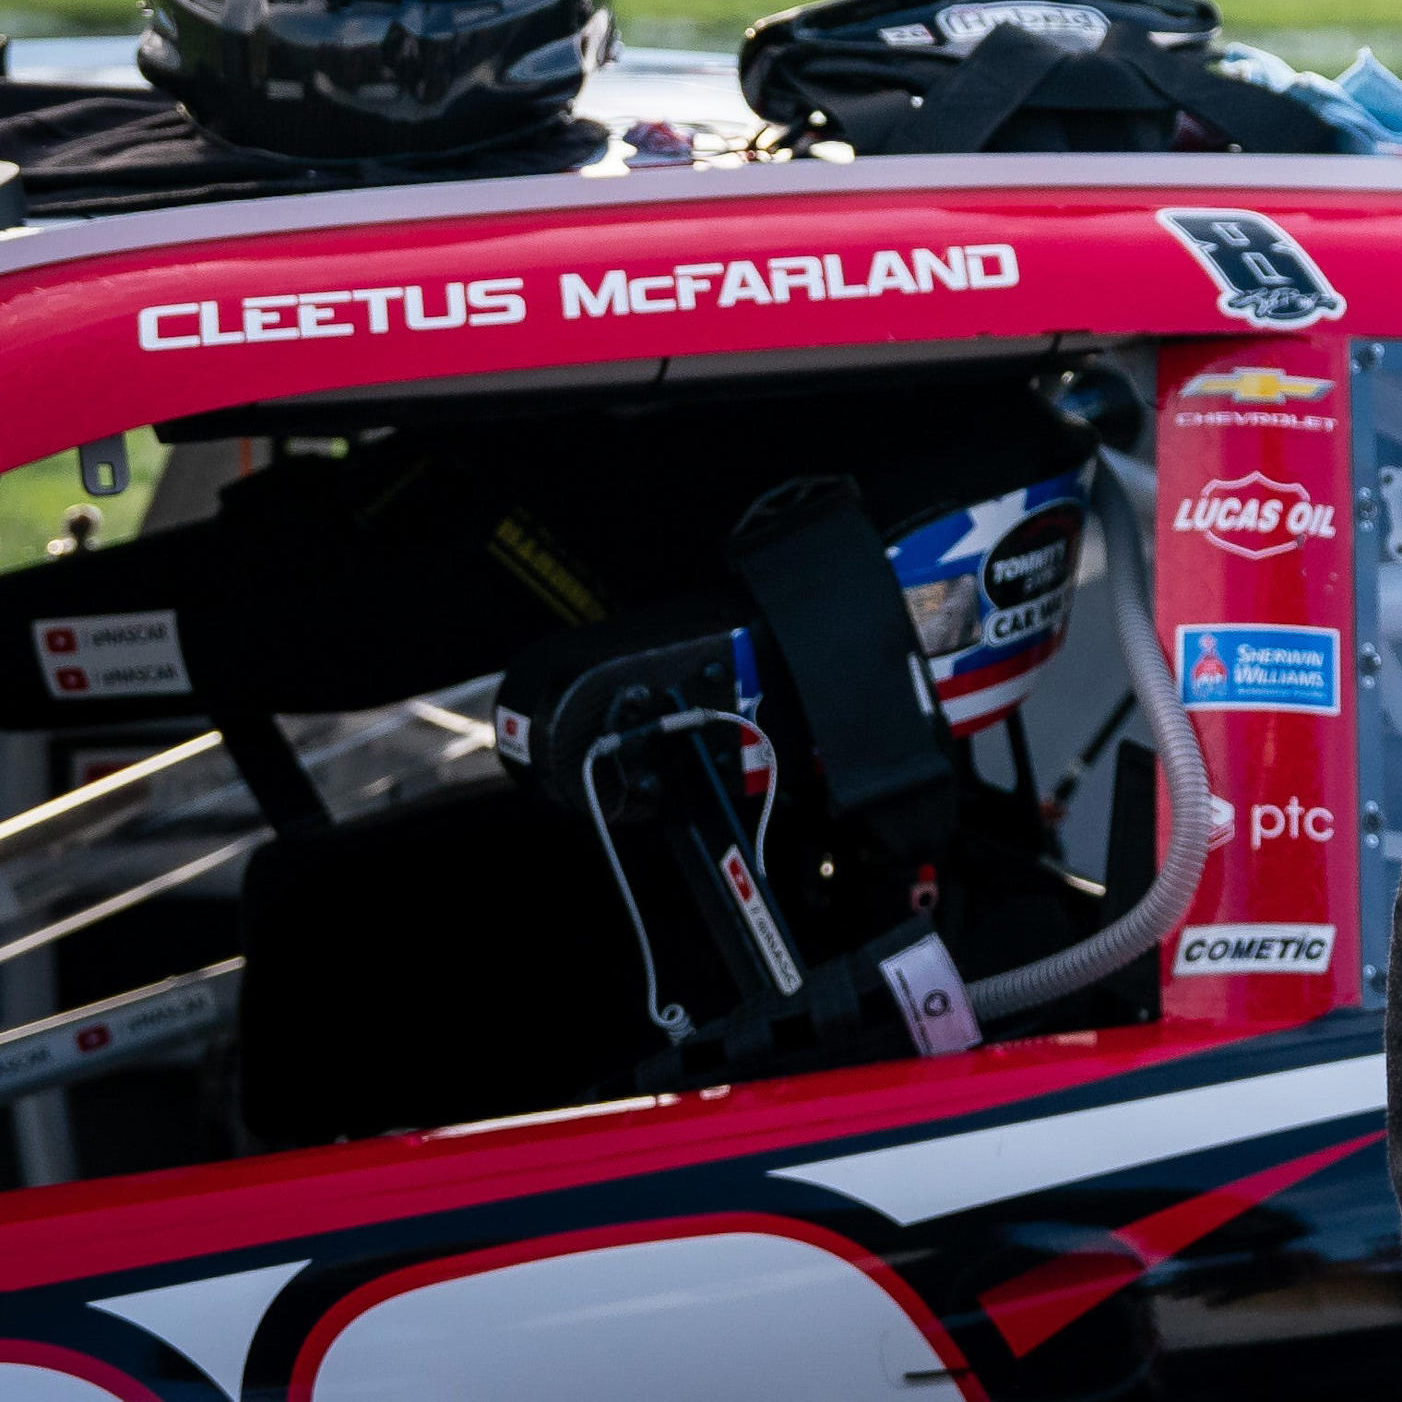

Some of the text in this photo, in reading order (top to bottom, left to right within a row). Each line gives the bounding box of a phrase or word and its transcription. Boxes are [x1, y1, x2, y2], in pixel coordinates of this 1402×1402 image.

[138, 243, 1020, 352] CLEETUS McFARLAND
[1176, 410, 1338, 431] CHEVROLET
[1173, 497, 1337, 539] LUCAS OIL
[1236, 643, 1325, 668] SHERWIN
[1233, 664, 1326, 688] WILLIAMS
[1252, 795, 1335, 851] ptc
